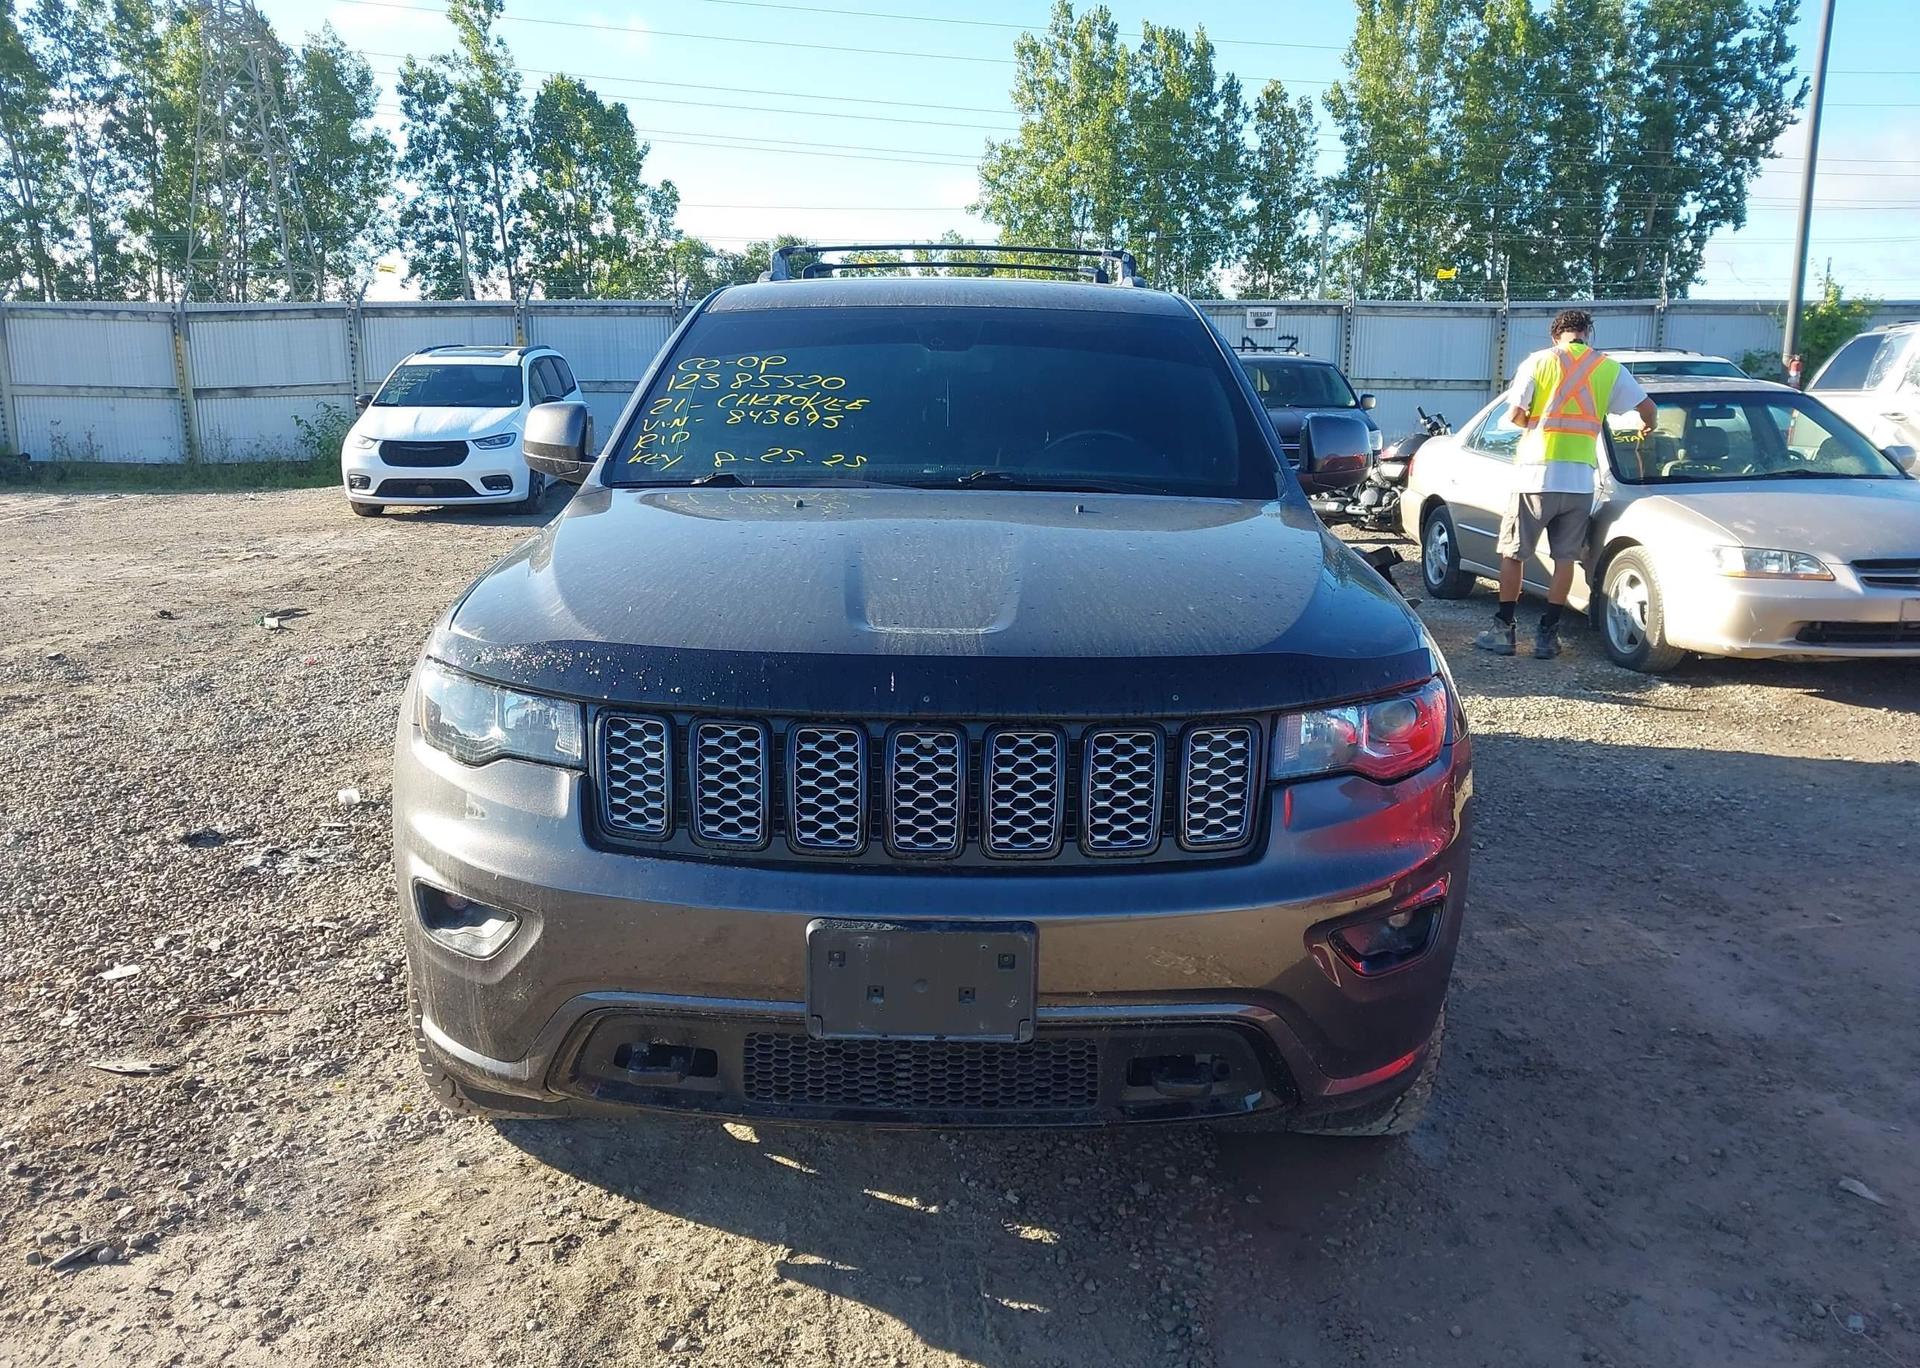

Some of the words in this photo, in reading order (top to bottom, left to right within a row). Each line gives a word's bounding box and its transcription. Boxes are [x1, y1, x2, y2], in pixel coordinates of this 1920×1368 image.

[678, 356, 787, 373] CO-OP
[717, 391, 871, 412] CHEROKEE
[726, 409, 844, 429] 843695
